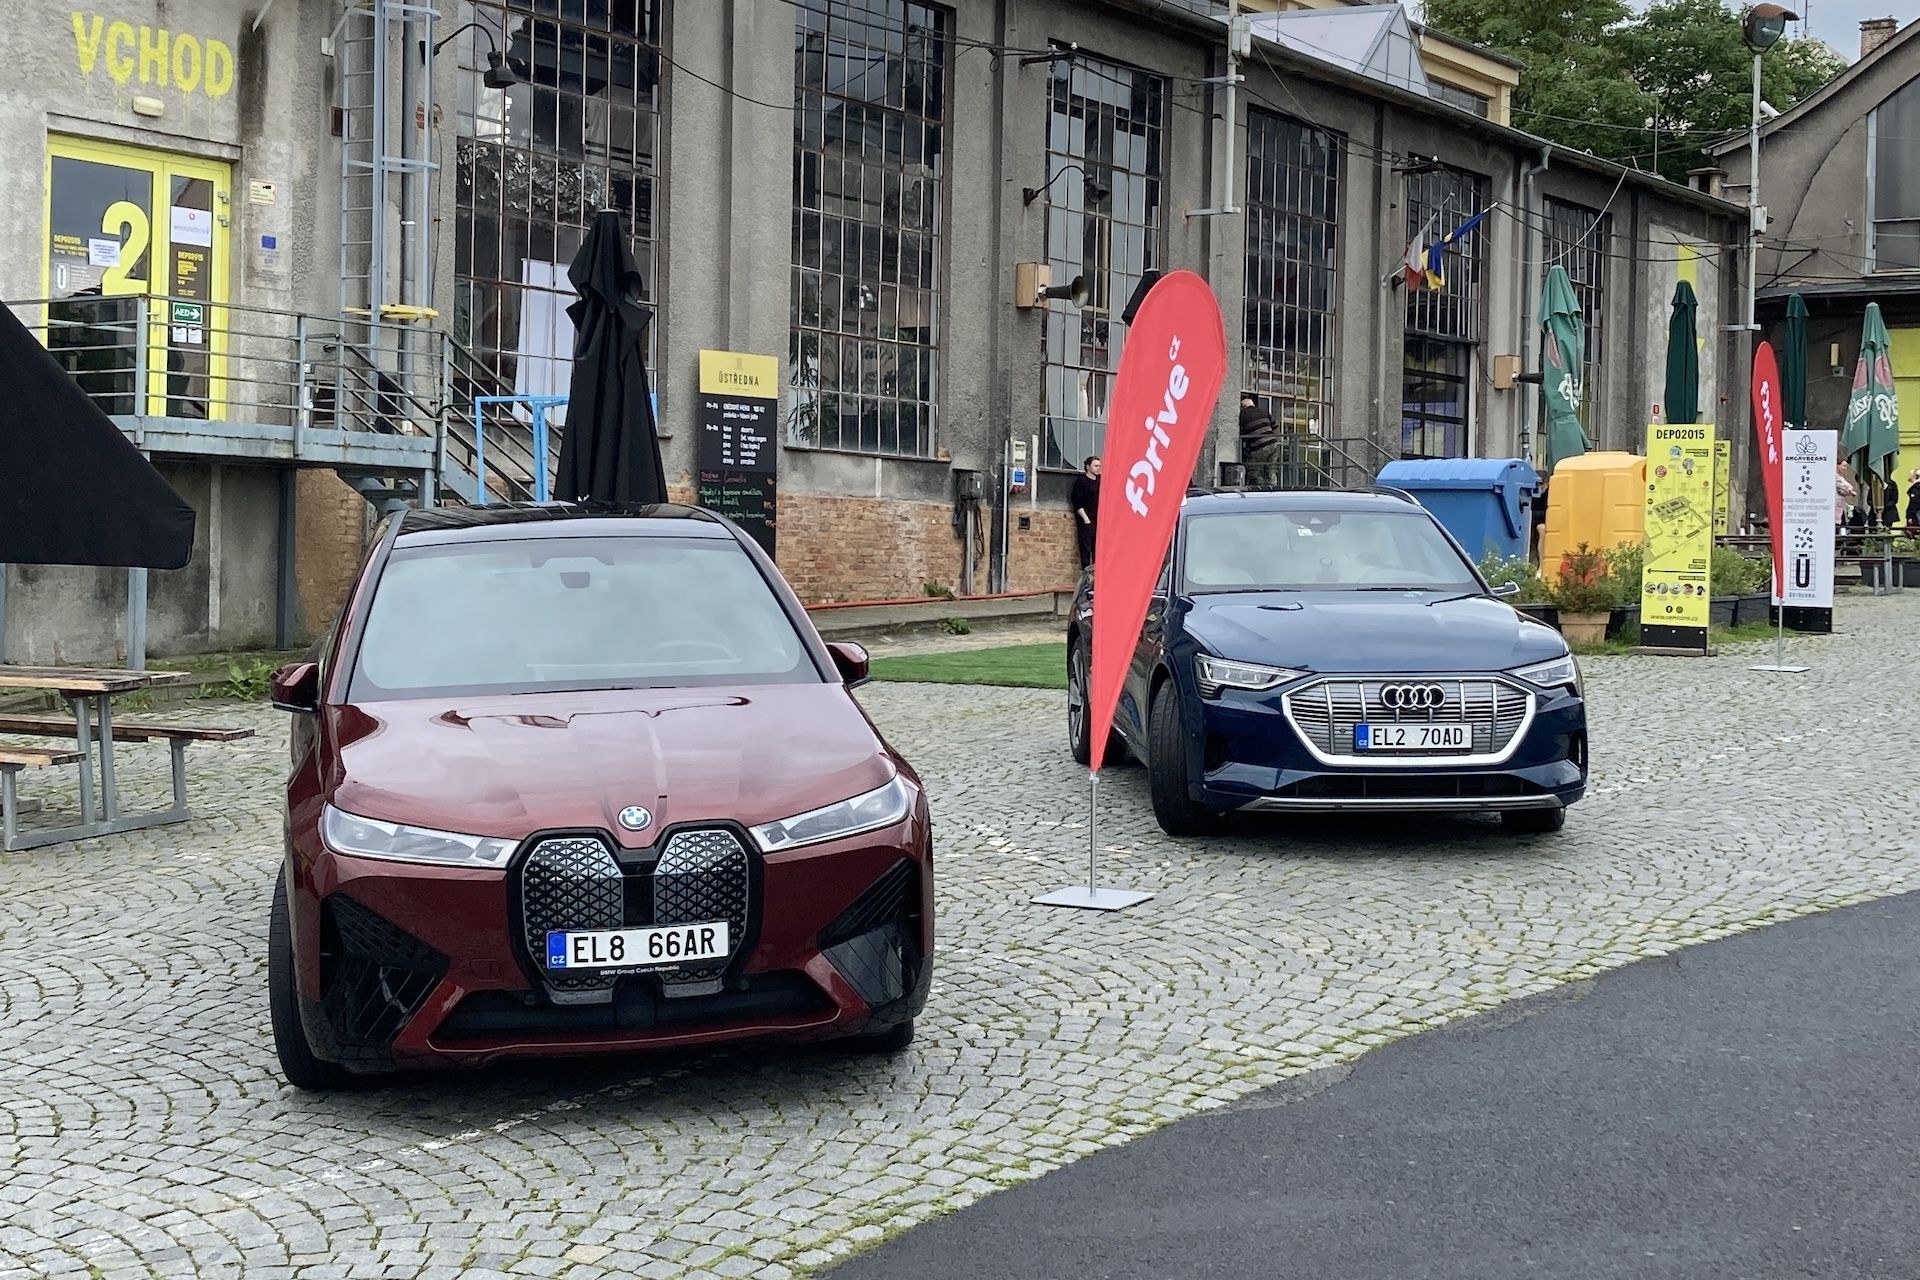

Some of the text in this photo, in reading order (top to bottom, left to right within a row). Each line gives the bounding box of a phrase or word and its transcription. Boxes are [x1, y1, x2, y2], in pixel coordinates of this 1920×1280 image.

[71, 11, 234, 98] VCHOD
[102, 201, 149, 296] 2
[174, 307, 190, 317] AED
[1169, 335, 1181, 361] cz
[1656, 429, 1705, 440] DEPO2015
[1372, 728, 1406, 746] EL2
[1420, 727, 1463, 746] 70AD
[551, 928, 715, 964] CZ EL8 66AR
